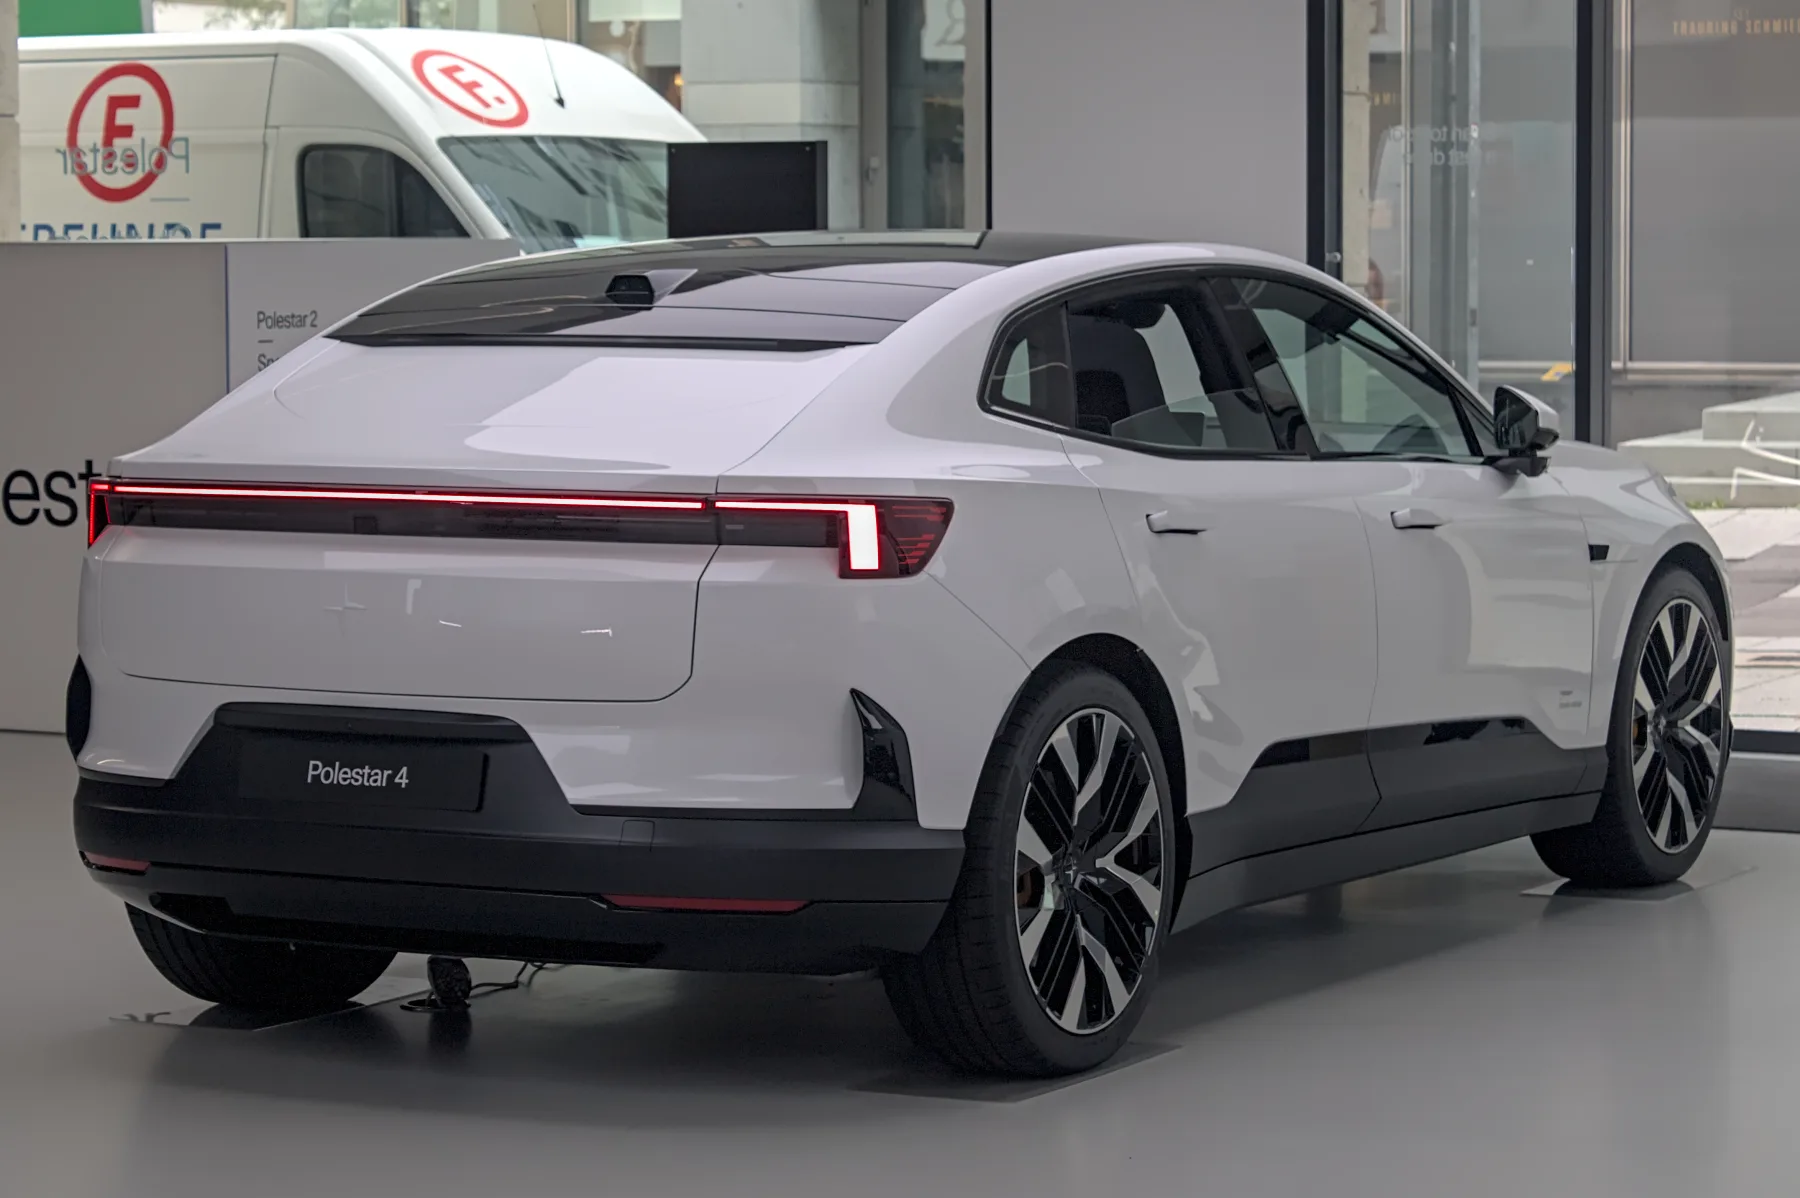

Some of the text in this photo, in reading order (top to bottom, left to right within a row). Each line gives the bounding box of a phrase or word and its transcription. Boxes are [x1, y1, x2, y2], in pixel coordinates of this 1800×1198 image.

[257, 309, 319, 329] Polestar 2
[307, 760, 409, 789] Polestar 4
